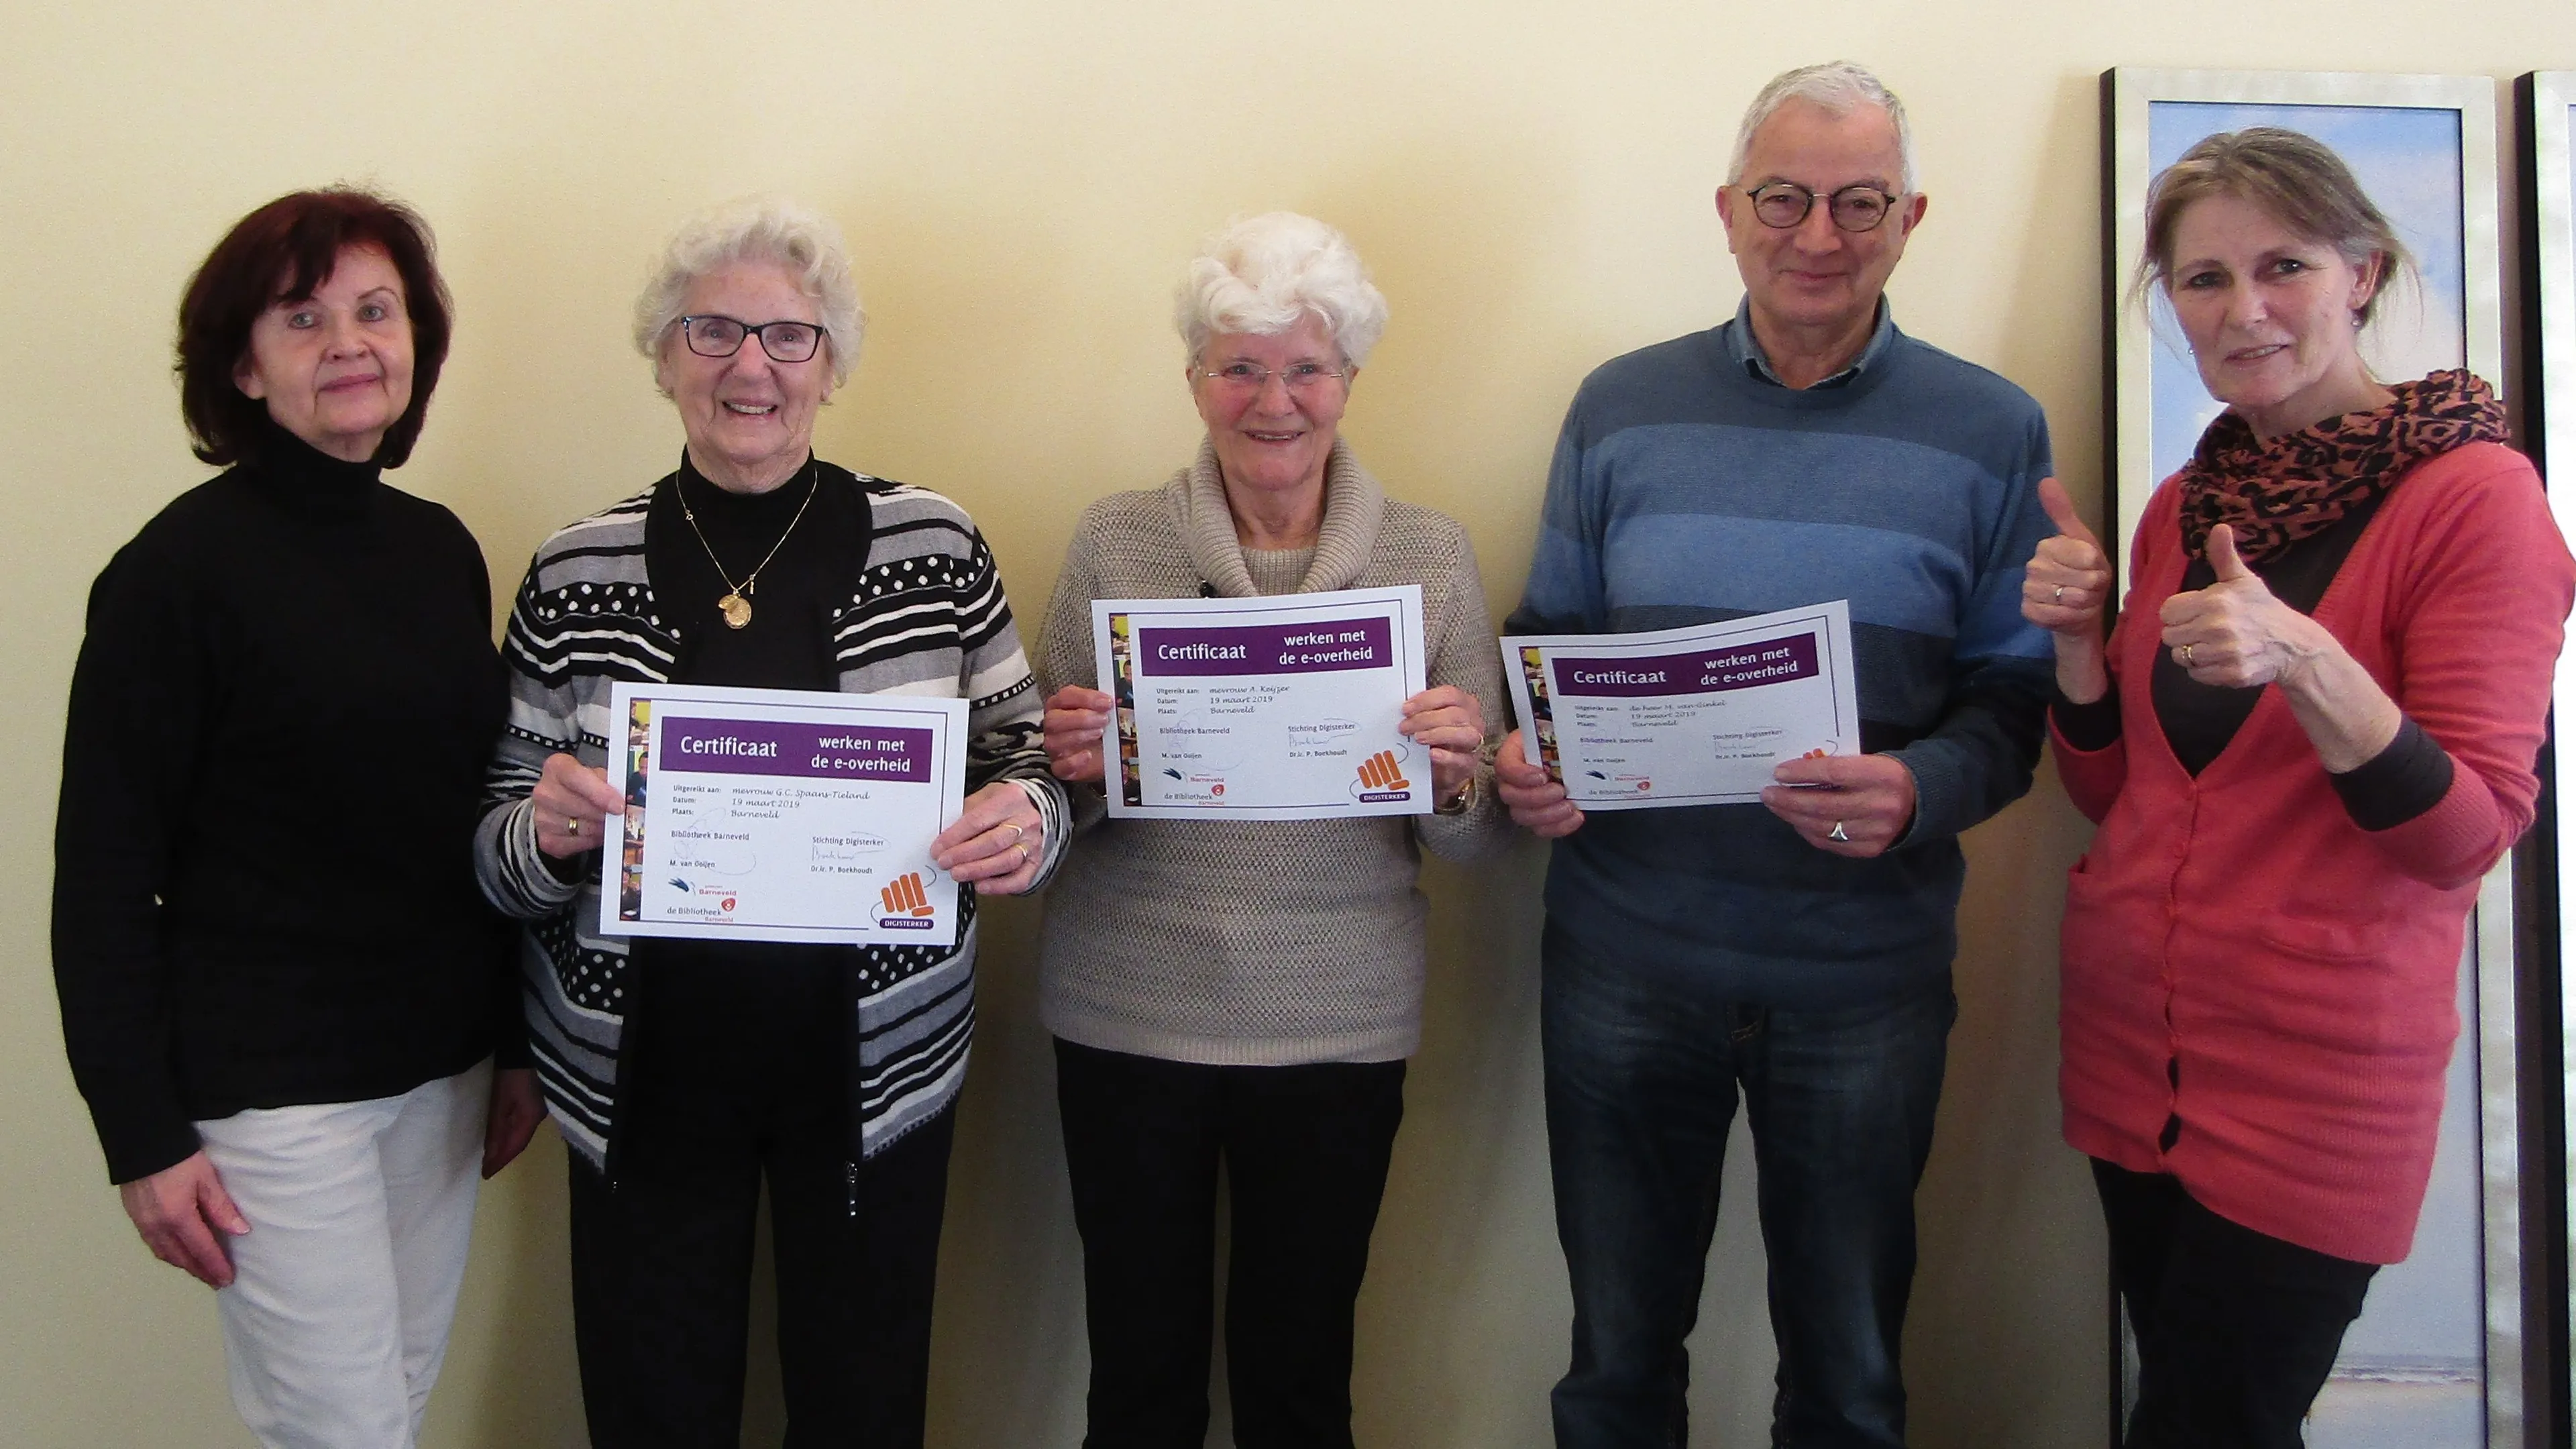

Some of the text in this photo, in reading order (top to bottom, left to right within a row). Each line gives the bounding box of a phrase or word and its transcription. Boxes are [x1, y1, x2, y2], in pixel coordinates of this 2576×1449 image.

[1284, 630, 1365, 647] werken met
[1158, 644, 1246, 660] Certificaat
[1279, 647, 1373, 665] de e-overheid
[1705, 647, 1790, 669] werken met
[1573, 671, 1666, 684] Certificaat
[1700, 661, 1798, 685] de e-overheid
[1210, 706, 1256, 714] Barneveld
[1319, 724, 1355, 732] Digisterker
[680, 735, 777, 757] Certificaat
[819, 735, 905, 753] werken met
[810, 754, 911, 773] de e-overheid
[673, 785, 705, 793] Uitgereikt
[732, 788, 774, 796] mevrouw
[732, 798, 800, 808] 19 maart 2019
[672, 808, 694, 816] Plaats:
[731, 809, 780, 819] Barneveld
[671, 830, 750, 841] Bibliotheek Barneveld
[812, 836, 884, 847] Stichting Digisterker
[837, 866, 873, 874] Boekhoudt
[667, 906, 722, 916] de Bibliotheek
